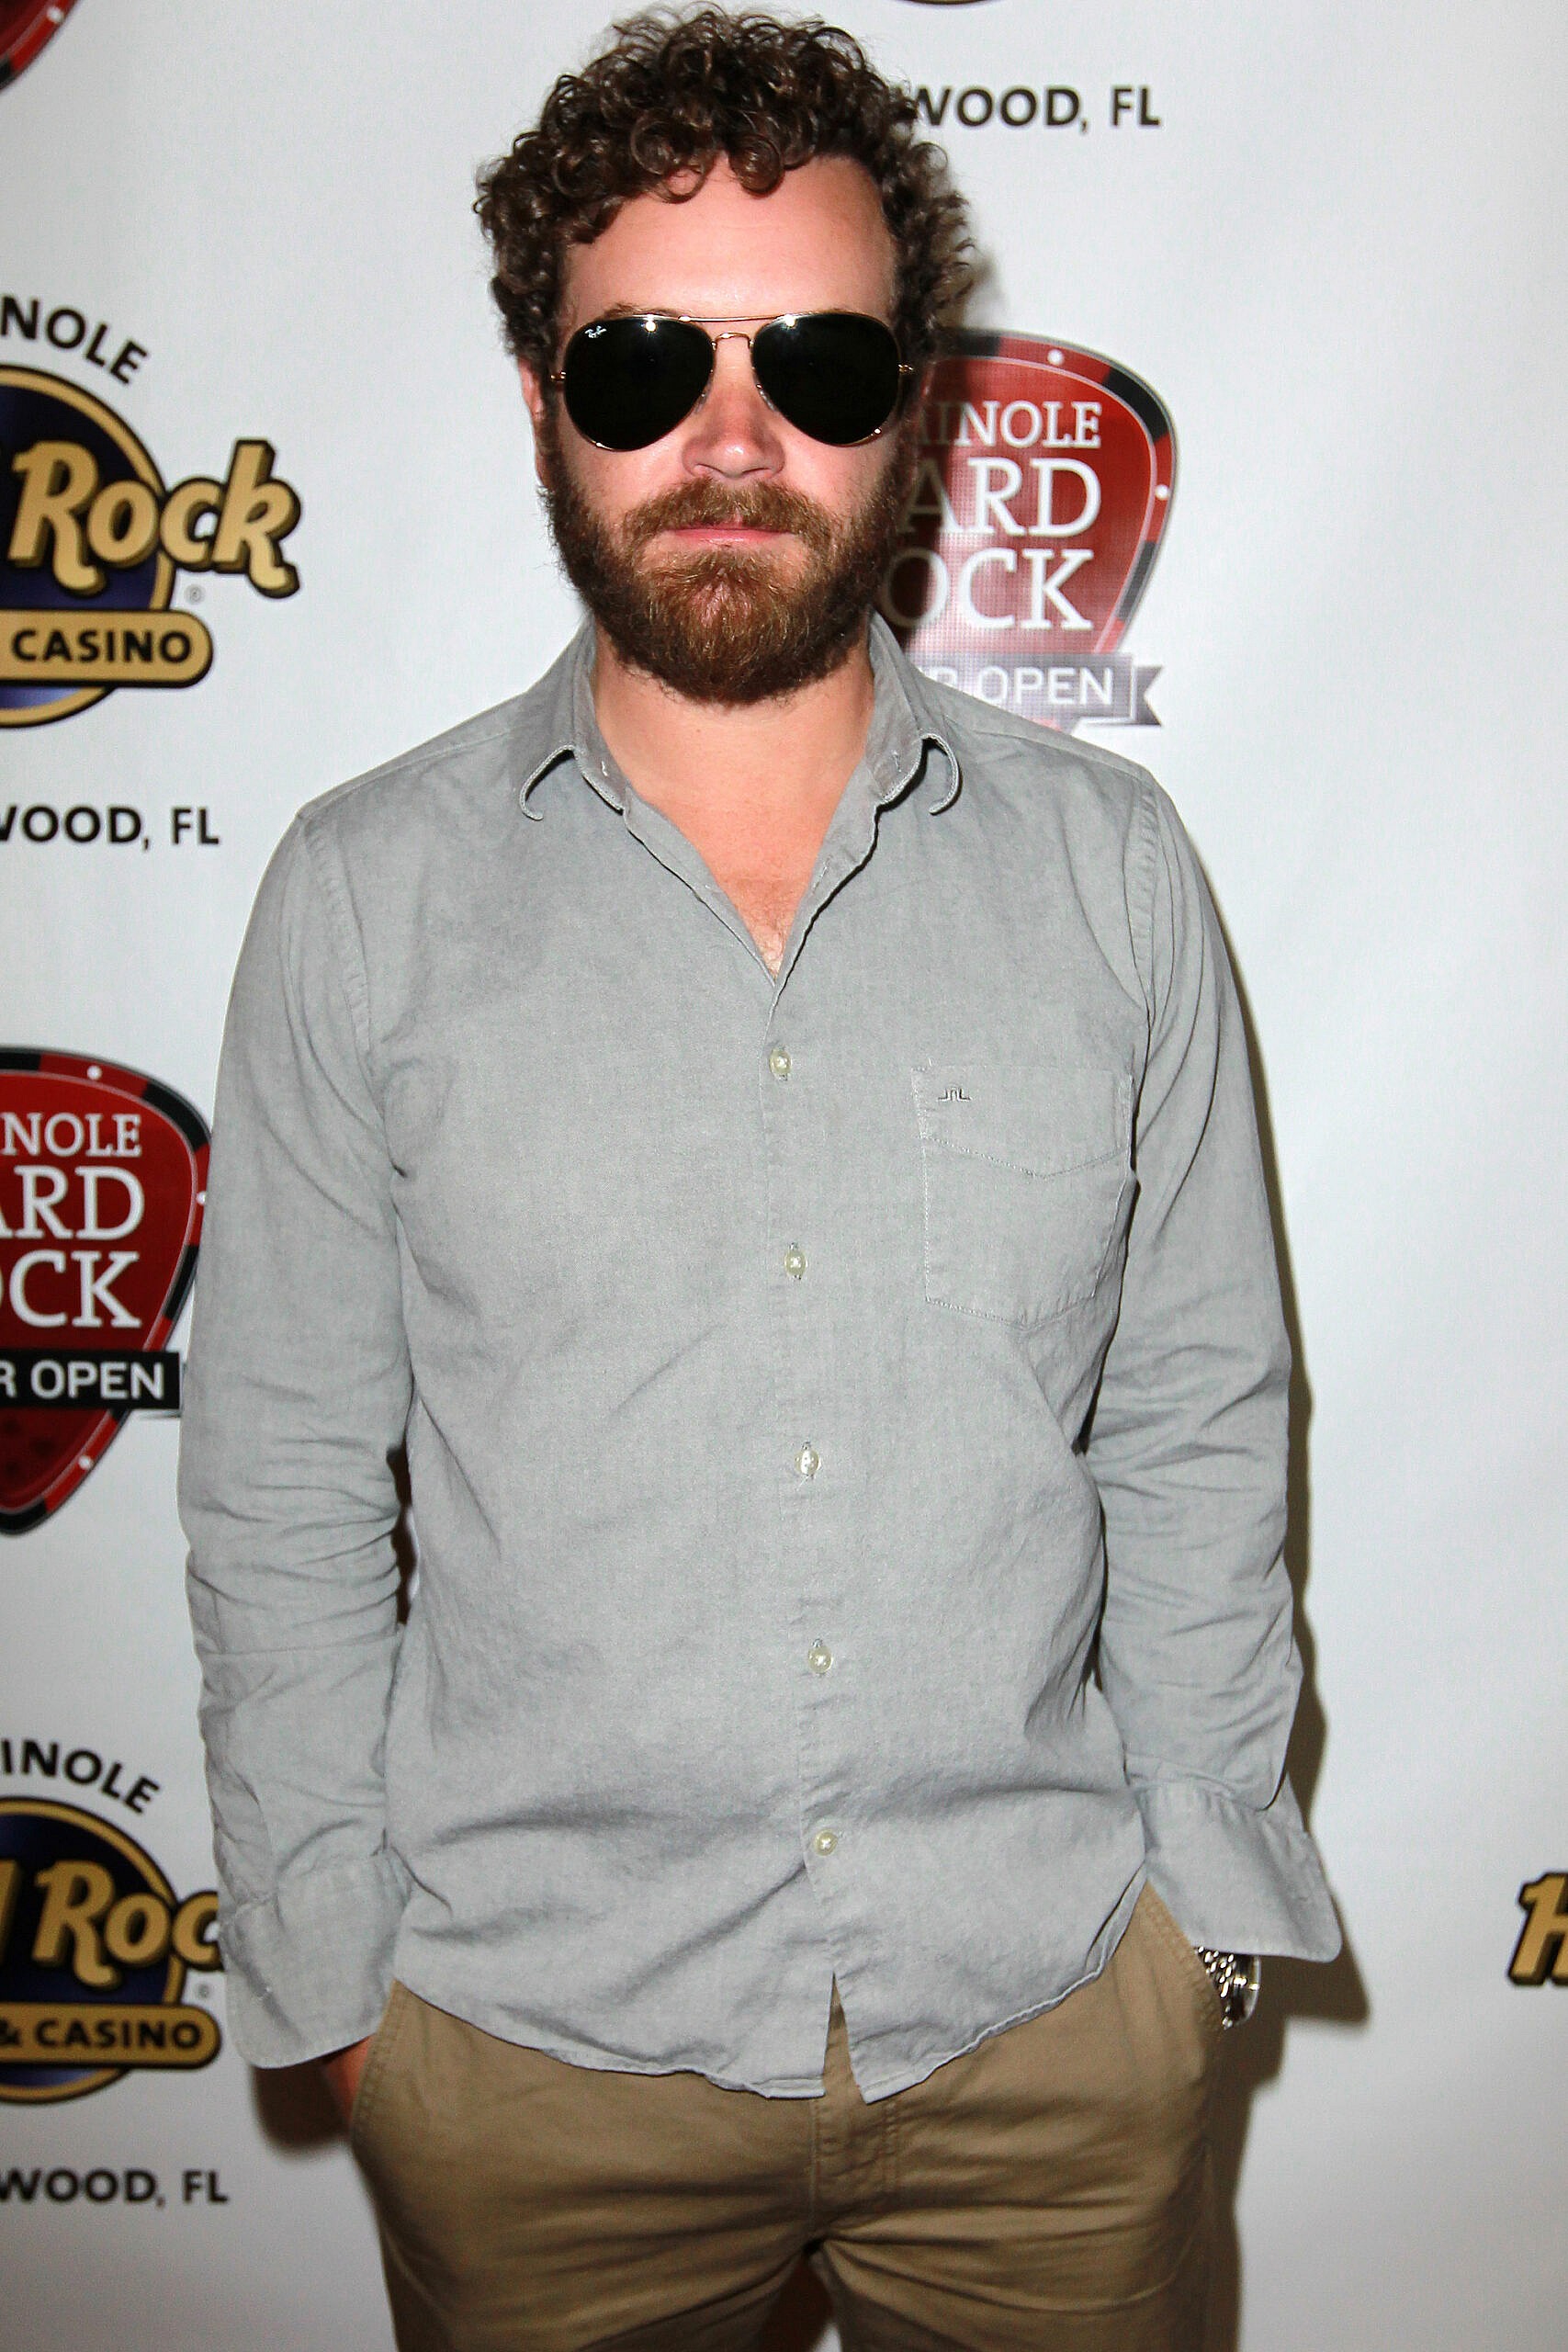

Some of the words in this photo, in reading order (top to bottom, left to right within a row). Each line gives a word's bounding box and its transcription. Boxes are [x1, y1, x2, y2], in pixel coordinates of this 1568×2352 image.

[1111, 86, 1161, 127] FL
[0, 295, 148, 384] NOLE
[6, 436, 302, 600] Rock
[12, 628, 192, 663] CASINO
[976, 664, 1114, 706] OPEN
[172, 807, 220, 845] FL
[0, 1112, 142, 1158] NOLE
[0, 1164, 145, 1239] RD
[0, 1249, 142, 1329] CK
[30, 1359, 164, 1400] OPEN
[1, 1738, 161, 1815] INOLE
[35, 2019, 201, 2050] CASINO
[183, 2169, 229, 2203] FL
